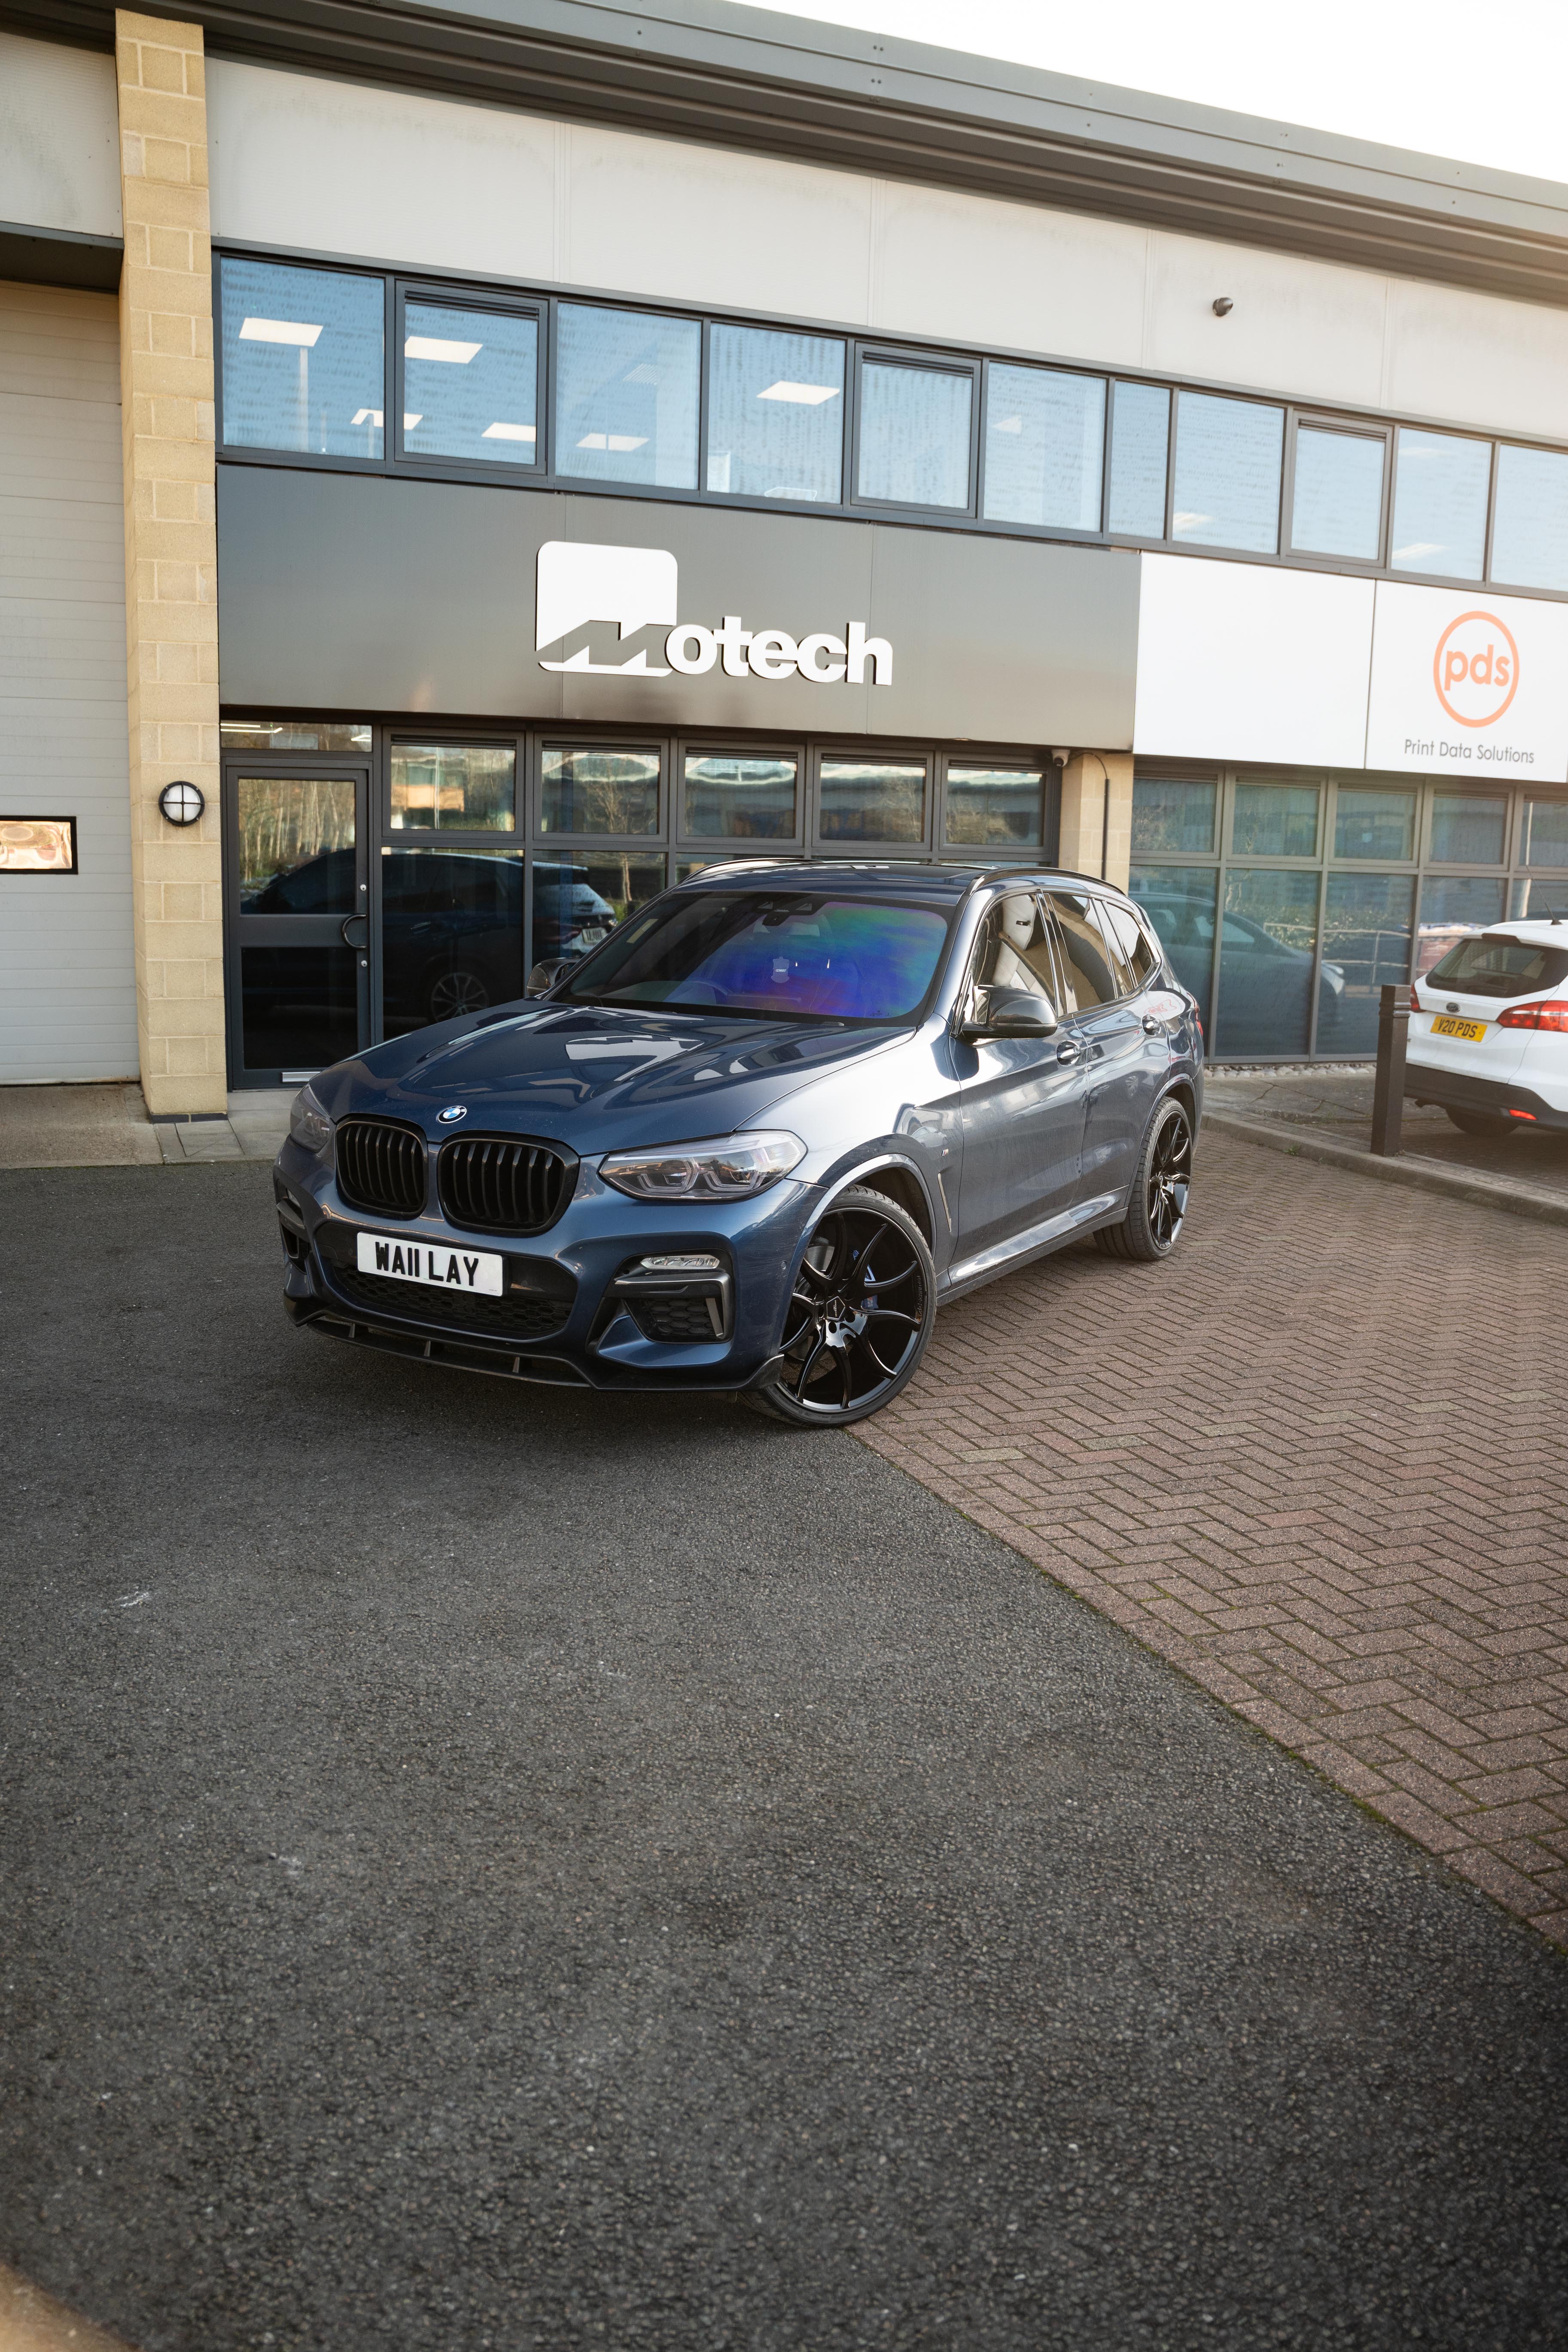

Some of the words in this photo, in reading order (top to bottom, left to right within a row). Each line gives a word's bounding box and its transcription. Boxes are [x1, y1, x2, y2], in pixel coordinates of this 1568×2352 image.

[1444, 644, 1510, 691] pds
[1404, 739, 1434, 756] Print
[1439, 741, 1472, 759] Data
[1477, 744, 1535, 764] Solutions
[1438, 1019, 1455, 1033] V20
[1455, 1022, 1477, 1038] PDS
[428, 1251, 479, 1287] LAY
